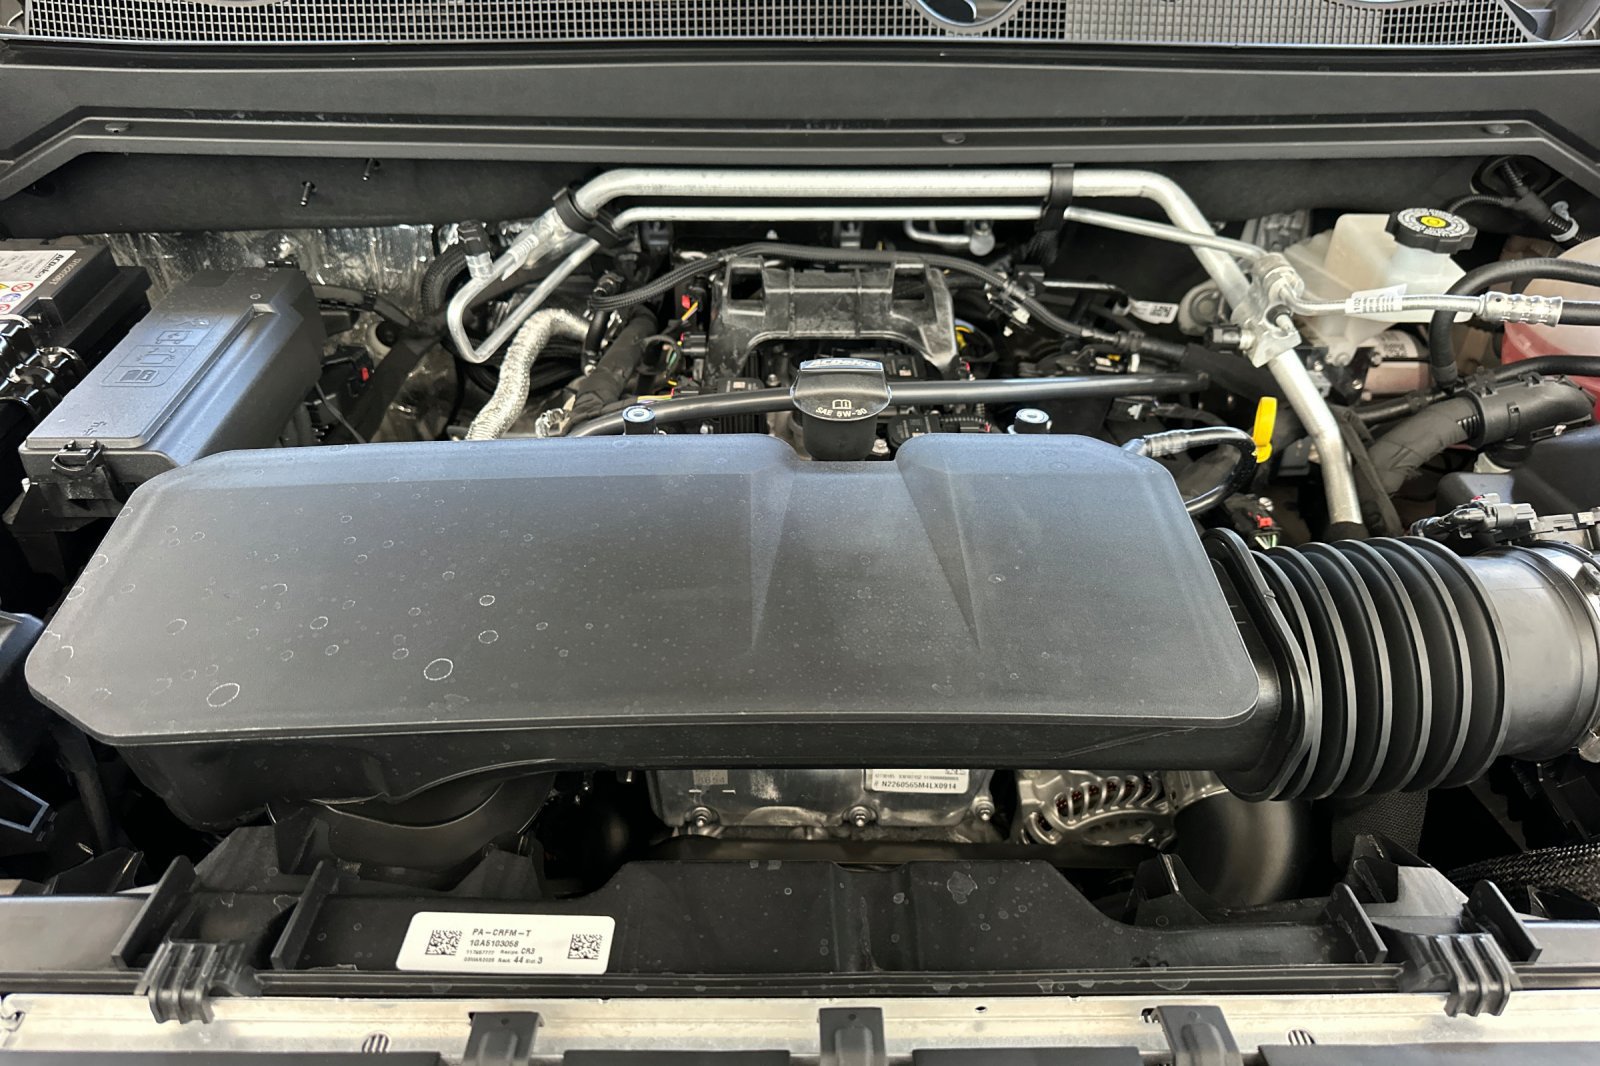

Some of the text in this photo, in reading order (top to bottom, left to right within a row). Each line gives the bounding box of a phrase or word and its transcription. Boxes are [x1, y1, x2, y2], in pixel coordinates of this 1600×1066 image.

[35, 254, 64, 279] ACDelco
[816, 406, 868, 418] SAE 5W-30
[521, 947, 536, 955] CR3
[513, 956, 524, 964] 44
[537, 956, 543, 964] 3
